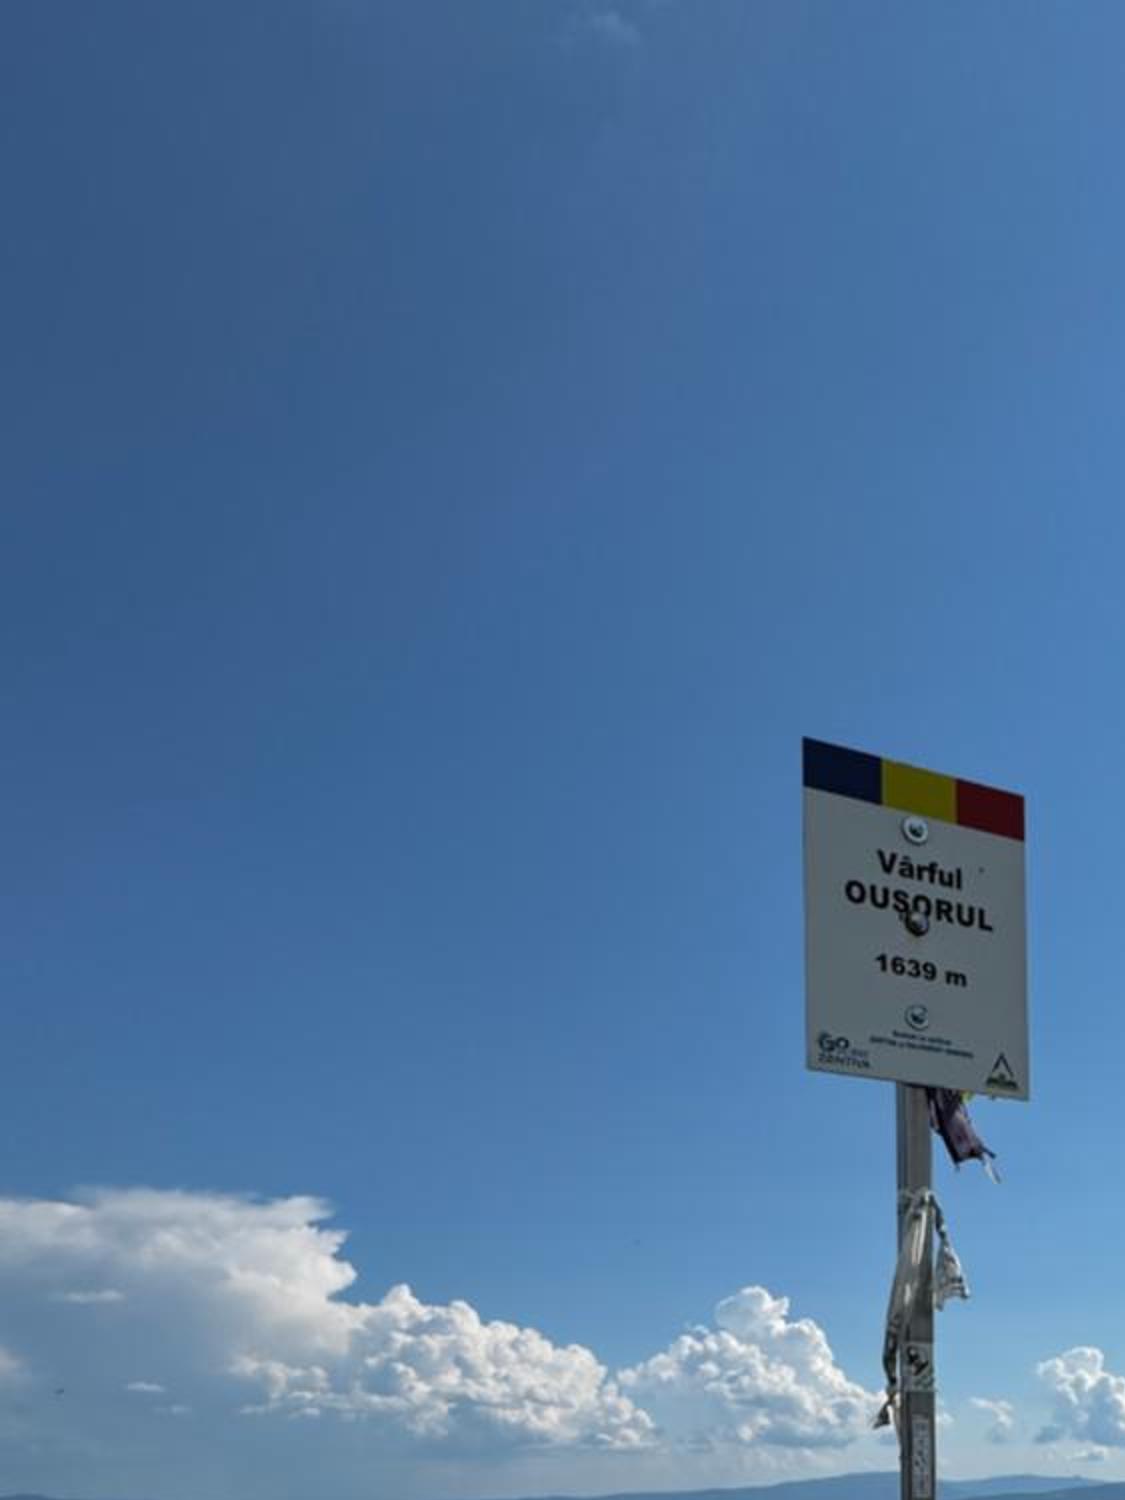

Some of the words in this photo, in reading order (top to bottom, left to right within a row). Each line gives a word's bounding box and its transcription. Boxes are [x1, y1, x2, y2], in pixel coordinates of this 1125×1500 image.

[877, 848, 962, 890] Vârful
[875, 953, 937, 983] 1639
[946, 969, 968, 988] m
